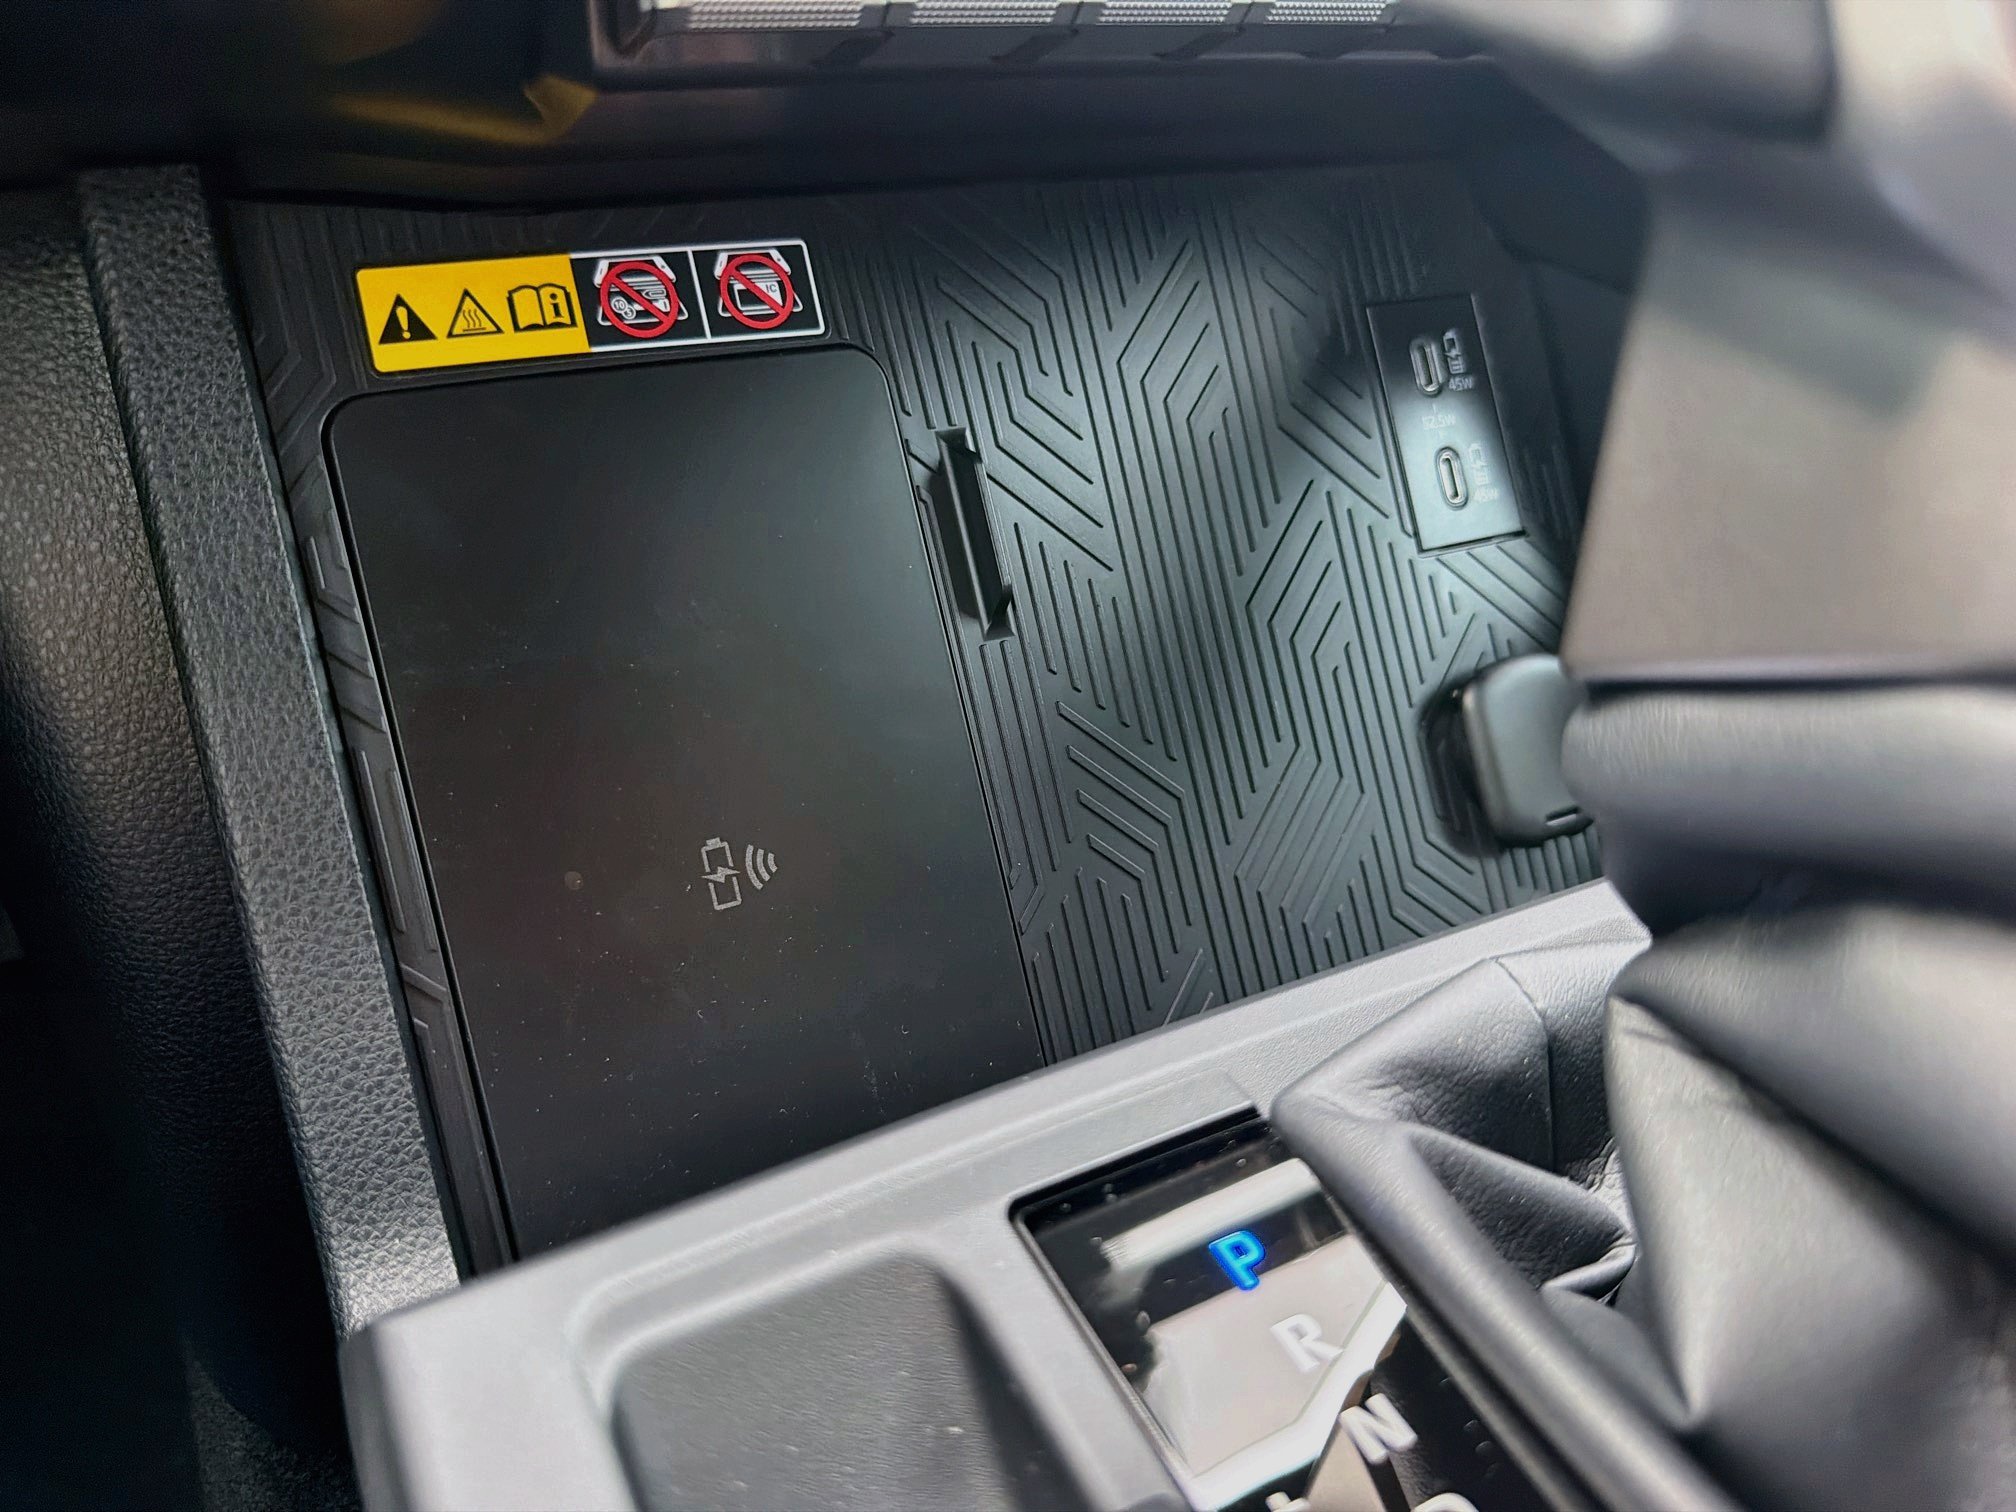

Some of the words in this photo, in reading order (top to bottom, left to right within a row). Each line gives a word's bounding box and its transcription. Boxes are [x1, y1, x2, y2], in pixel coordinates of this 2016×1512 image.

[765, 284, 777, 293] IC
[548, 292, 562, 318] i
[614, 301, 625, 310] 10
[1449, 376, 1472, 391] 45W
[1208, 1230, 1266, 1290] P
[1270, 1313, 1343, 1373] R
[1340, 1392, 1419, 1465] N
